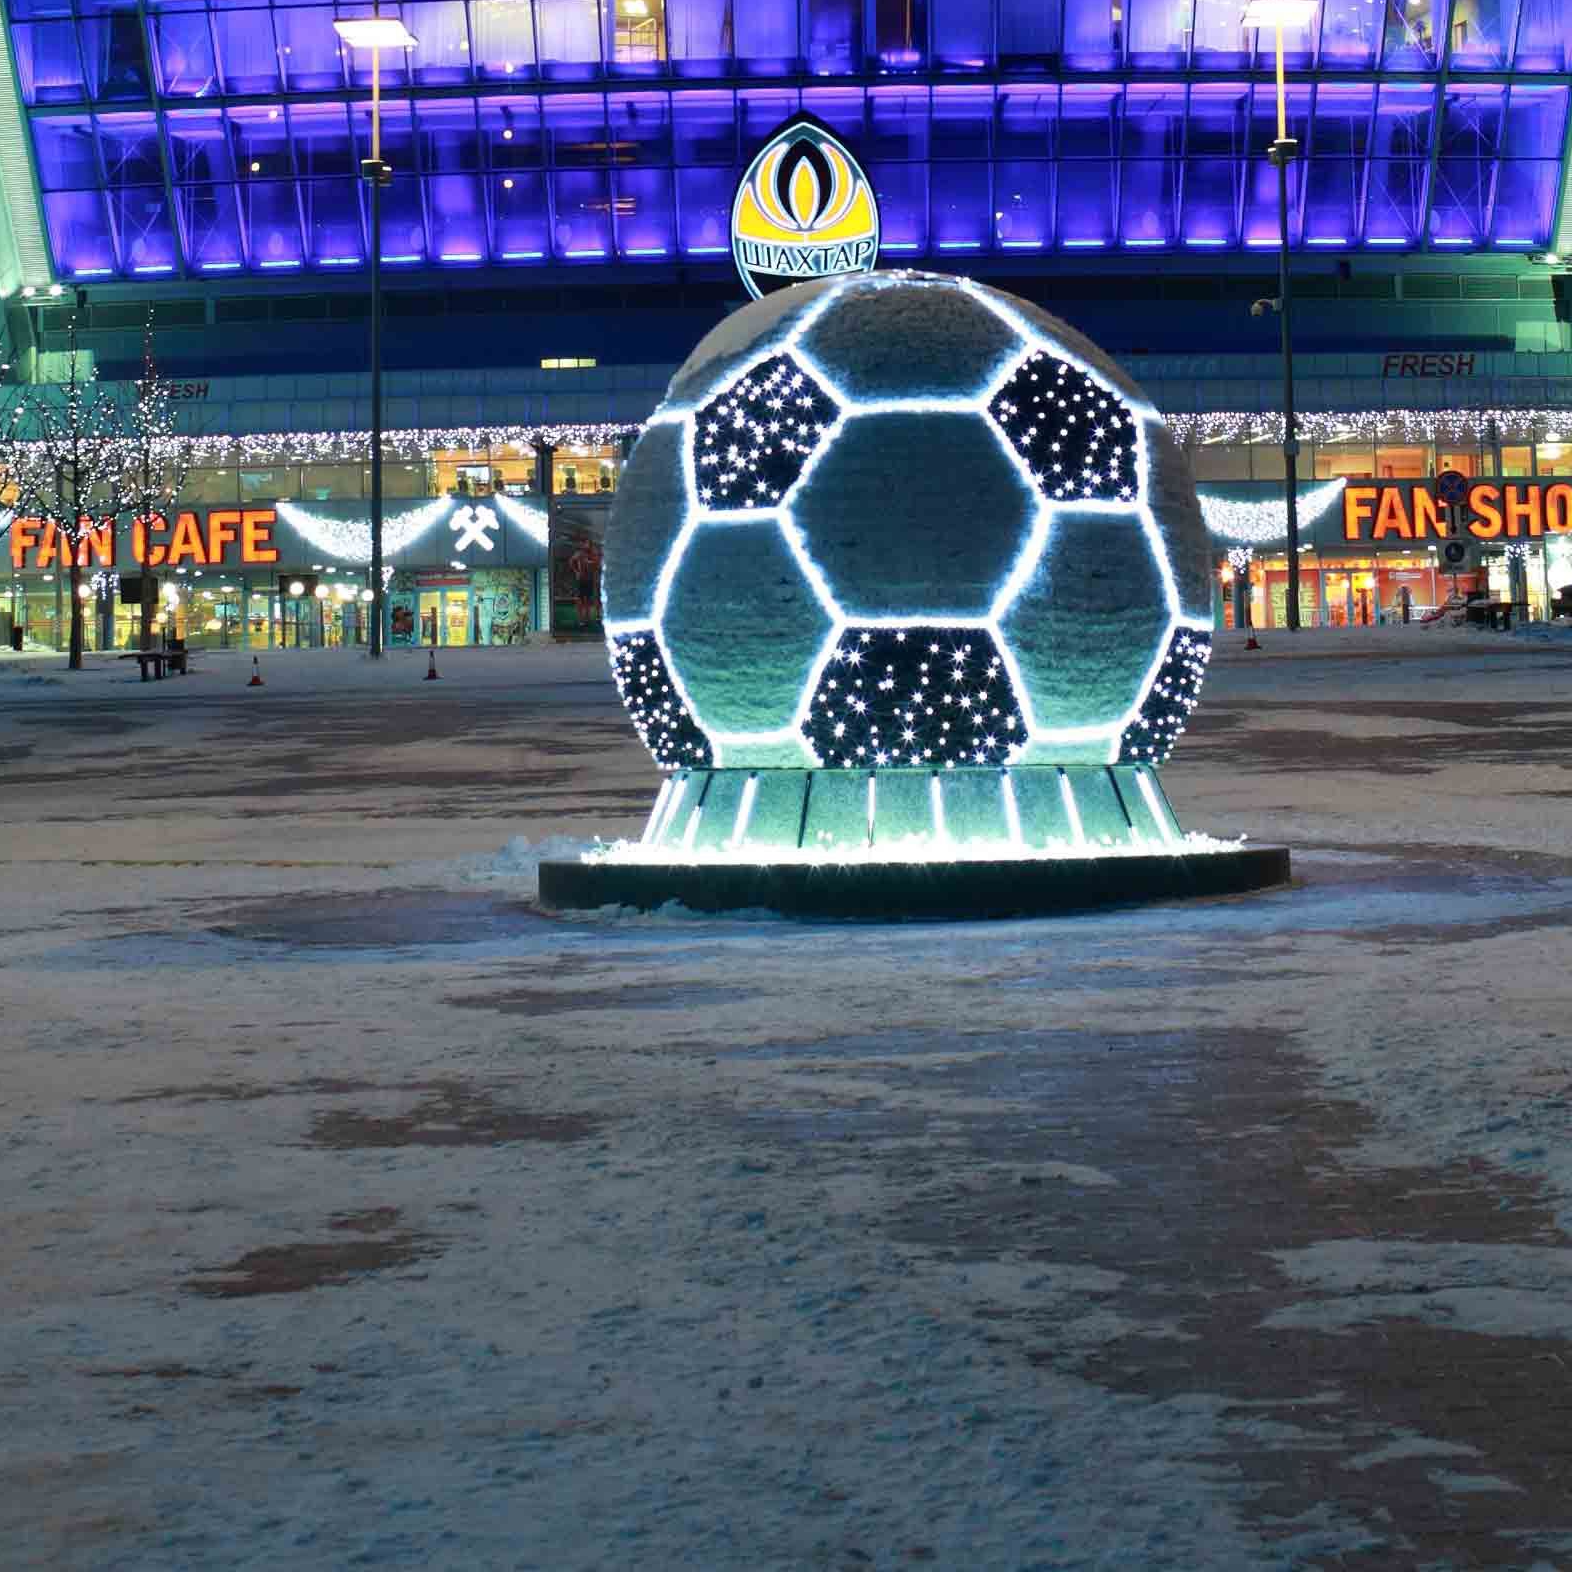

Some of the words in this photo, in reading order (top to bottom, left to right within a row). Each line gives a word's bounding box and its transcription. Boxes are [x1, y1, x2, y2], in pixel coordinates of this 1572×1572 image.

[741, 240, 871, 272] ШАХТАР
[1383, 354, 1475, 376] FRESH
[1342, 485, 1448, 540] FAN
[10, 515, 113, 567] FAN
[131, 510, 279, 566] CAFE
